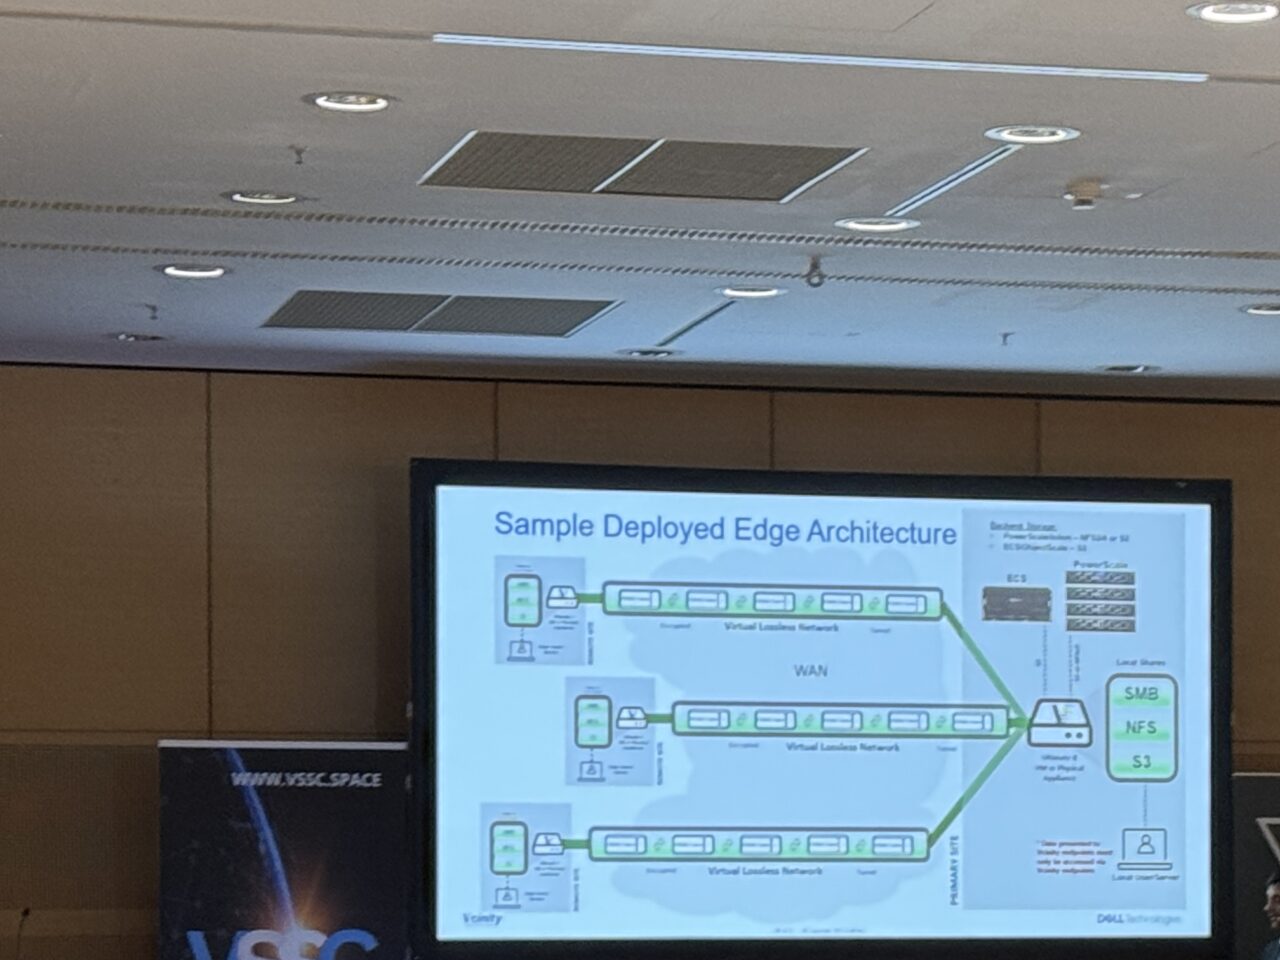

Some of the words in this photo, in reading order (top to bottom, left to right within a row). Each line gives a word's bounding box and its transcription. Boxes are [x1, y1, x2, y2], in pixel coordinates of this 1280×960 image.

[495, 511, 594, 542] Sample
[604, 514, 725, 545] Deployed
[735, 517, 800, 547] Edge
[806, 519, 957, 545] Architecture
[1006, 573, 1027, 583] ECS
[725, 621, 757, 631] Virtual
[759, 622, 796, 632] Lossless
[798, 623, 839, 632] Network
[794, 664, 828, 678] WAN
[1124, 686, 1159, 701] SMB
[1126, 720, 1157, 734] NFS
[786, 742, 818, 752] Virtual
[820, 743, 857, 752] Lossless
[860, 743, 900, 752] Network
[1132, 755, 1152, 769] S3
[230, 771, 383, 788] WWW.VSSC.SPACE
[949, 835, 959, 856] SITE
[708, 867, 740, 876] Virtual
[742, 867, 780, 876] Lossless
[1097, 913, 1125, 924] DELL
